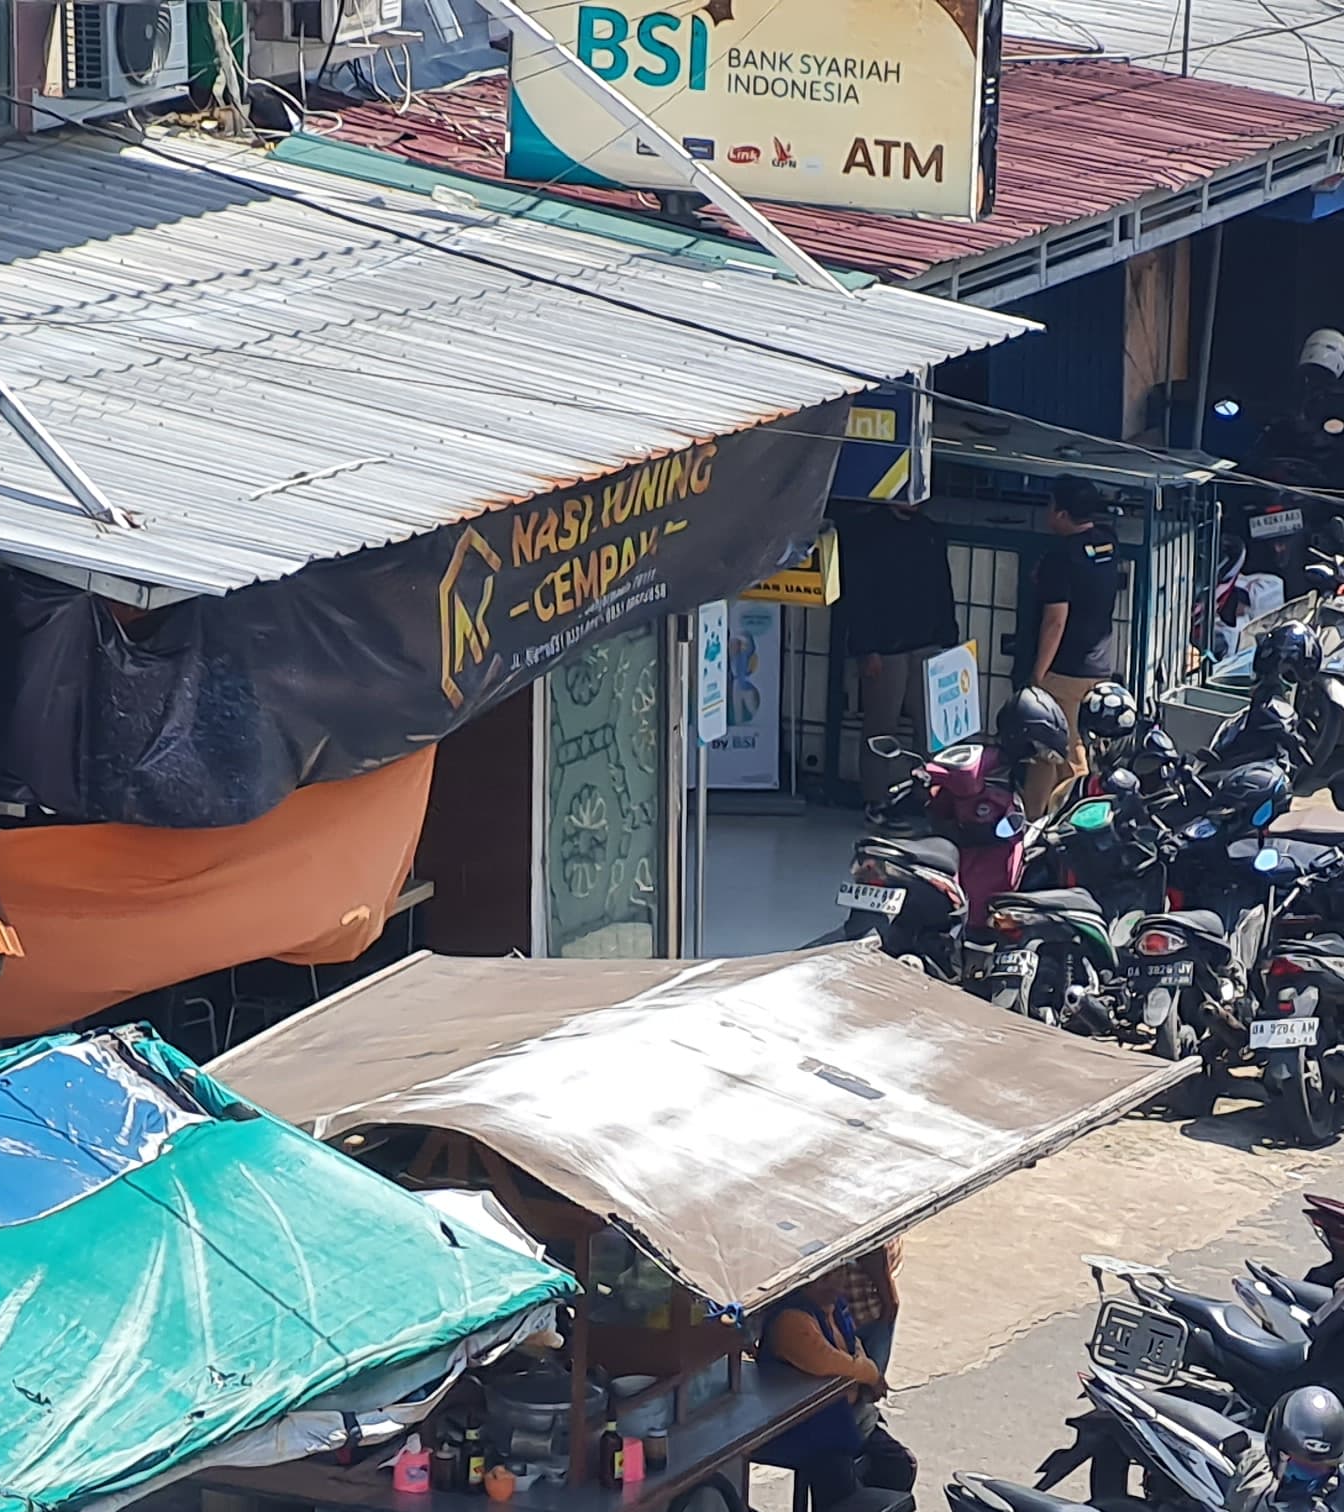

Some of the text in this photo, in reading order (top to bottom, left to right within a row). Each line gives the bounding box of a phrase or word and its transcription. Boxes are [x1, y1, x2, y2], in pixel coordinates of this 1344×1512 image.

[577, 5, 709, 92] BSI
[728, 48, 901, 84] BANK SYARIAH
[727, 74, 860, 105] INDONESIA
[843, 137, 944, 183] ATM
[512, 495, 594, 568] NASI
[785, 583, 823, 596] UANG
